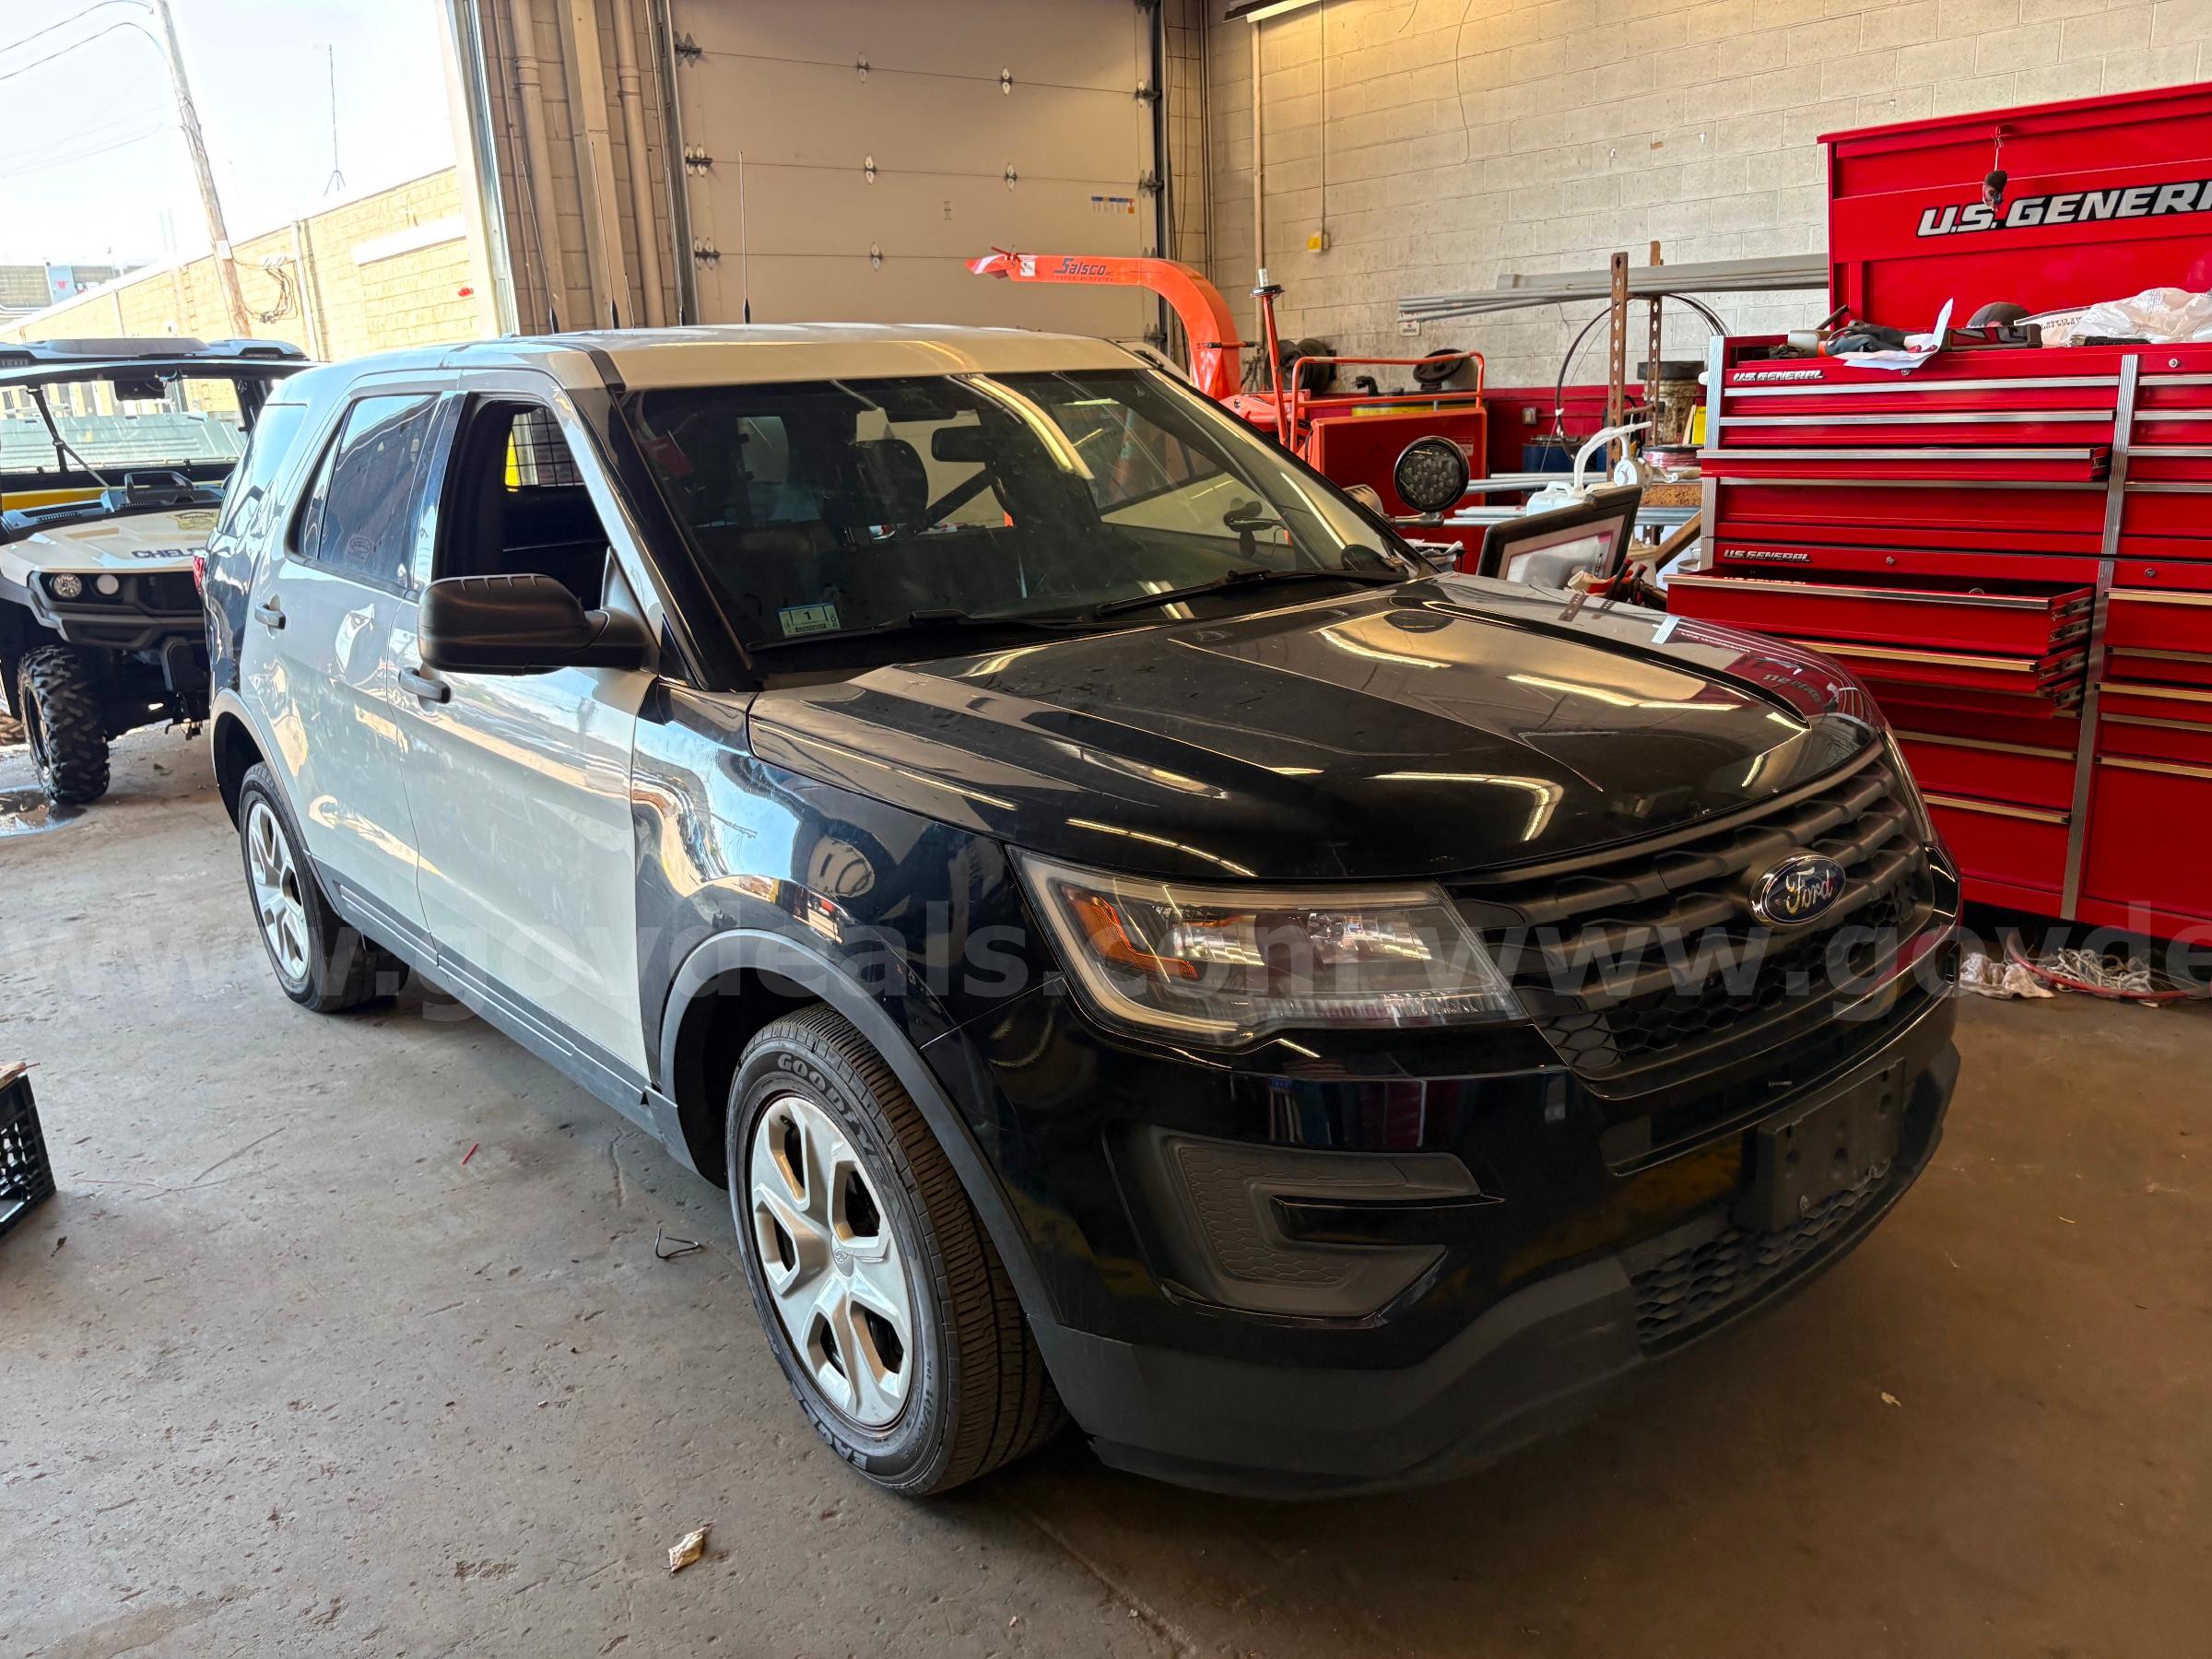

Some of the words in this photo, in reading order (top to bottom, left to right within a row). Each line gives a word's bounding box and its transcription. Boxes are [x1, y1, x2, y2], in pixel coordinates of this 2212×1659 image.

[2006, 181, 2212, 227] GENER
[1053, 257, 1106, 276] Salsco
[1758, 370, 1824, 382] GENERAL
[1747, 550, 1811, 562] GENERAL
[1785, 866, 1833, 914] Ford
